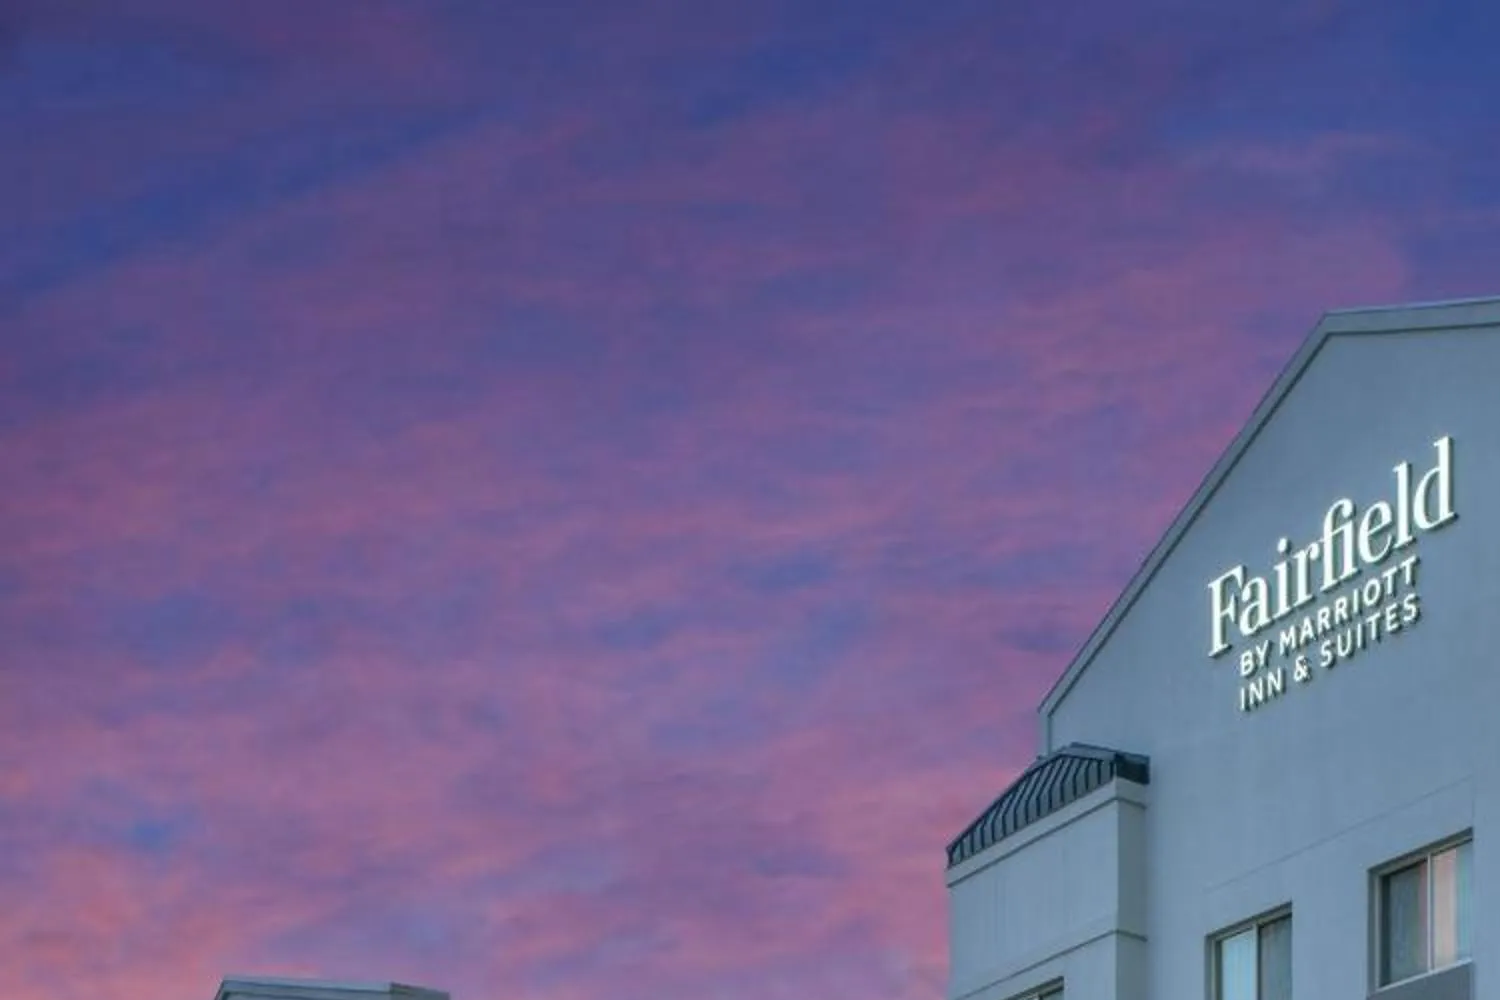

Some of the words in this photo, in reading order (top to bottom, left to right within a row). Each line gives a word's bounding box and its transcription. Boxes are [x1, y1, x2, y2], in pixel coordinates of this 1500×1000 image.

[1208, 435, 1456, 658] Fairfield
[1240, 639, 1270, 677] BY
[1279, 555, 1418, 656] MARRIOTT
[1240, 667, 1284, 711] INN
[1293, 655, 1310, 682] &
[1320, 593, 1419, 668] SUITES
